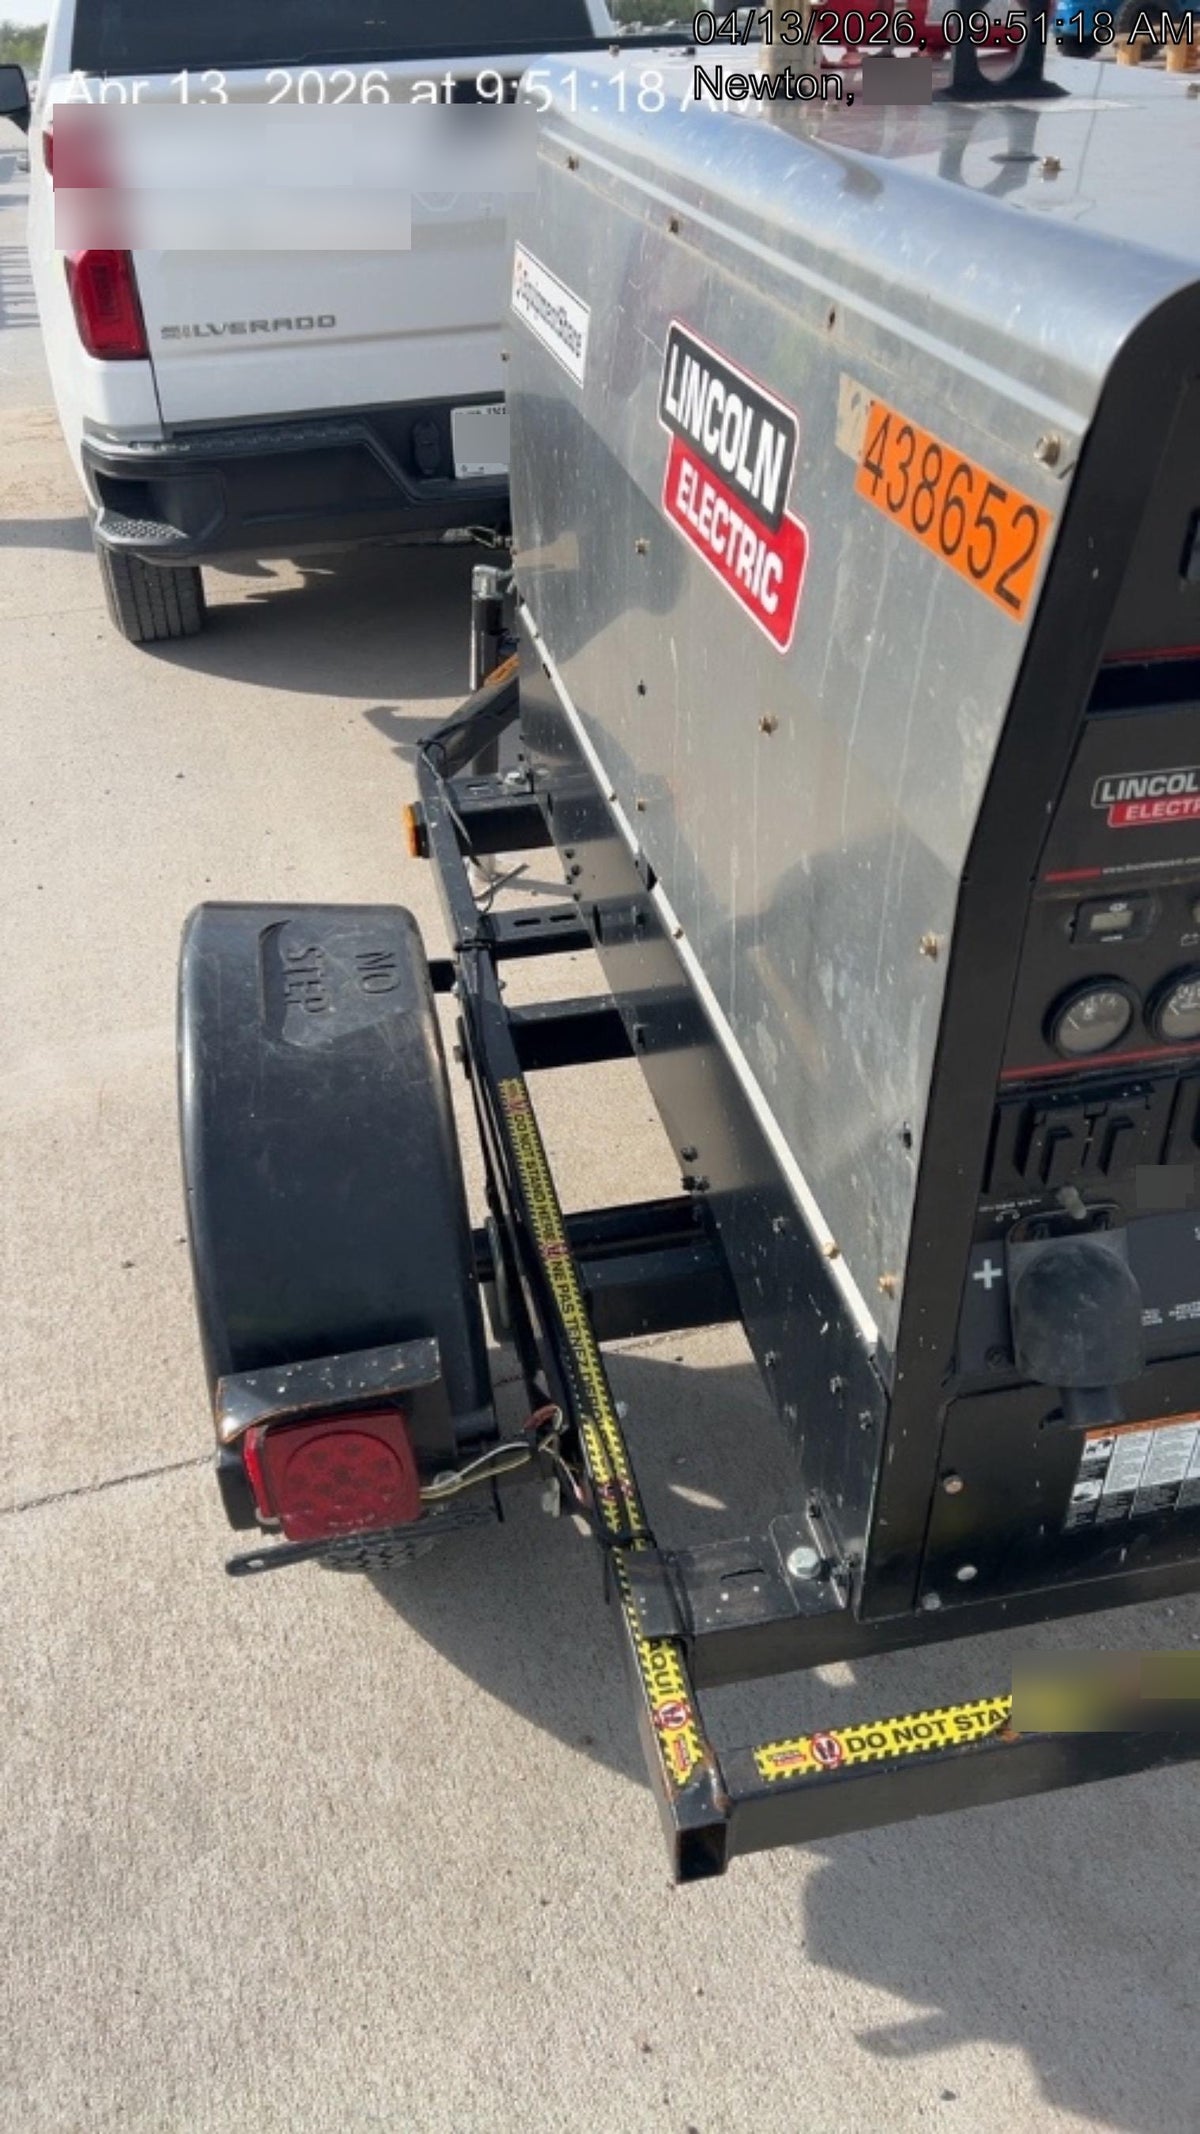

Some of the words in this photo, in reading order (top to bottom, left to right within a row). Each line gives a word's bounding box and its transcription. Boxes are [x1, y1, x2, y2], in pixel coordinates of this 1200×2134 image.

[160, 313, 337, 341] SILVERADO
[664, 343, 787, 516] LINCOLN
[863, 411, 1040, 611] 438652
[675, 456, 784, 616] ELECTRIC
[282, 945, 328, 1014] STEP
[354, 950, 402, 995] NO
[551, 1260, 567, 1282] NE
[556, 1283, 576, 1315] PAS
[845, 1732, 887, 1753] DO
[891, 1719, 947, 1743] NOT
[953, 1707, 1011, 1732] STA
